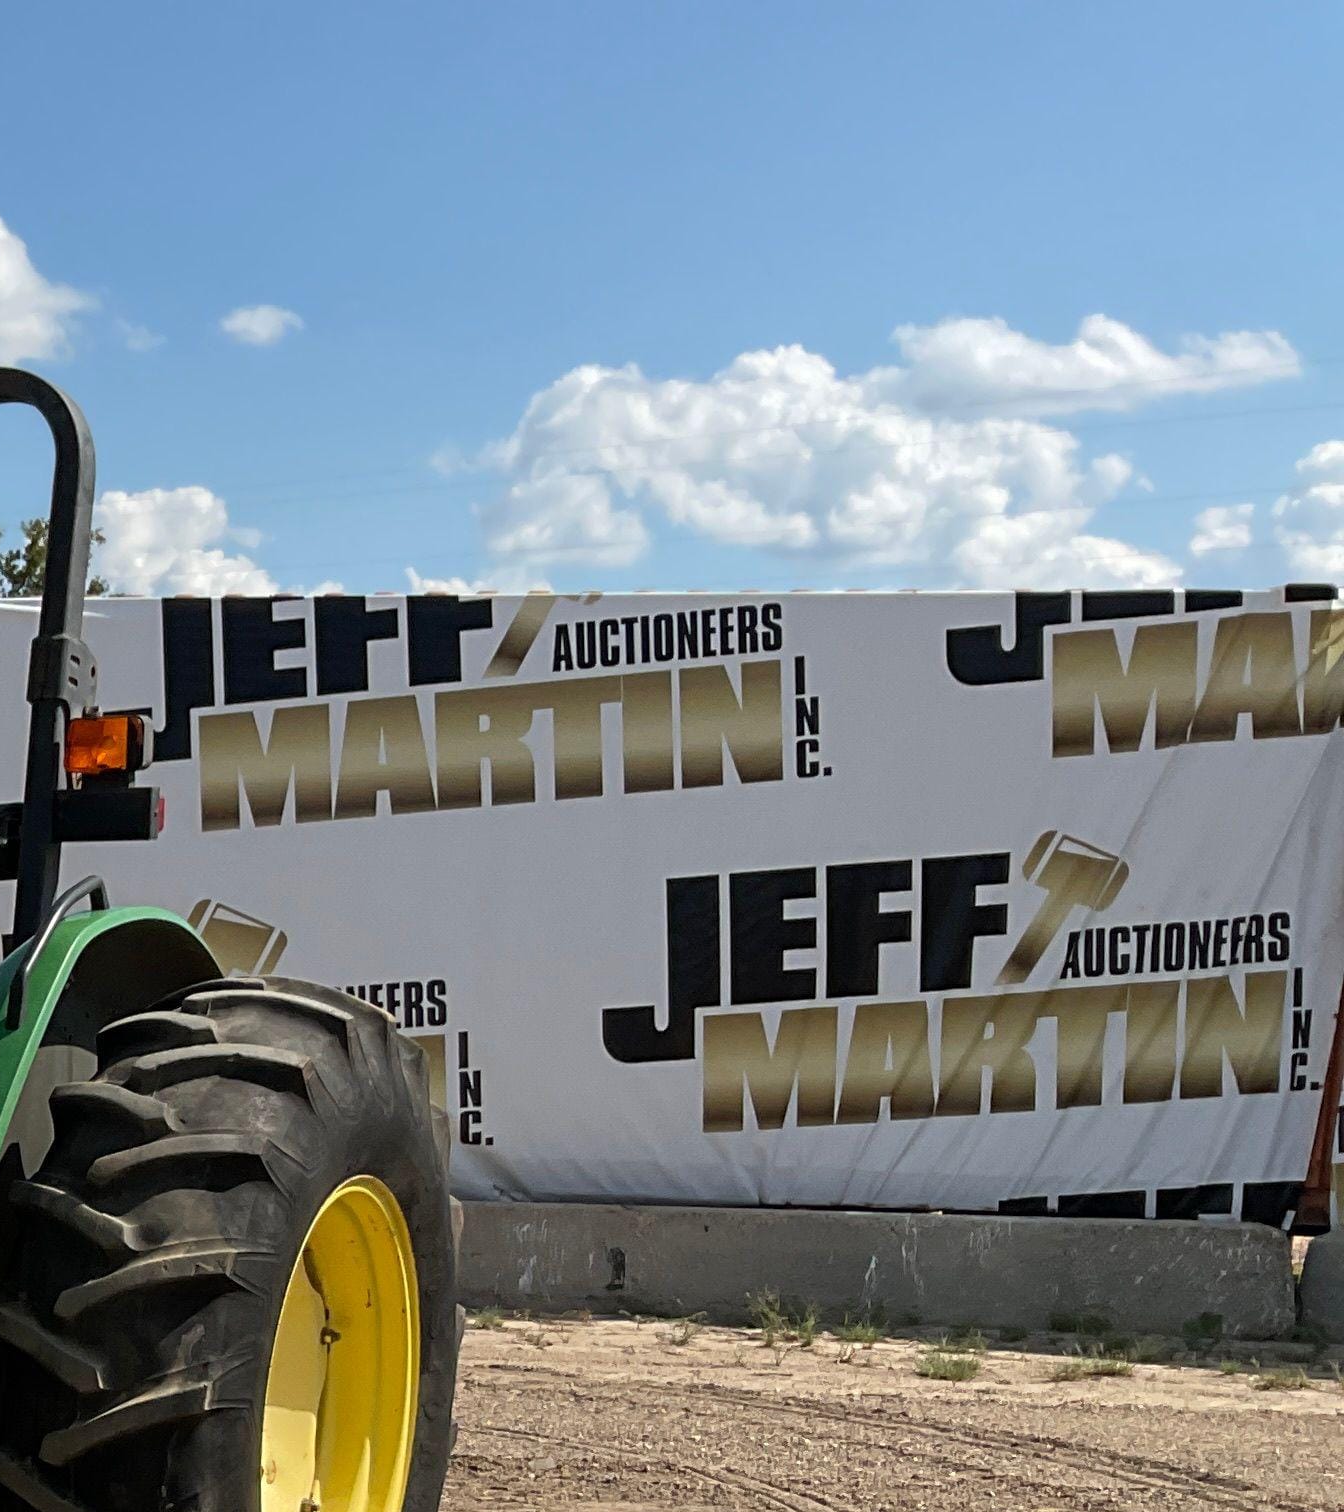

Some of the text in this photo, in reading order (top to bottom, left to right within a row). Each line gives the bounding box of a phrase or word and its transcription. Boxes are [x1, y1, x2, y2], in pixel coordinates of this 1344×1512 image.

[103, 595, 493, 761] JEFF
[553, 602, 783, 673] AUCTIONEERS
[199, 659, 784, 832] MARTIN
[602, 852, 1011, 1063] JEFF
[1060, 912, 1291, 980] AUCTIONEERS
[702, 969, 1288, 1133] MARTIN
